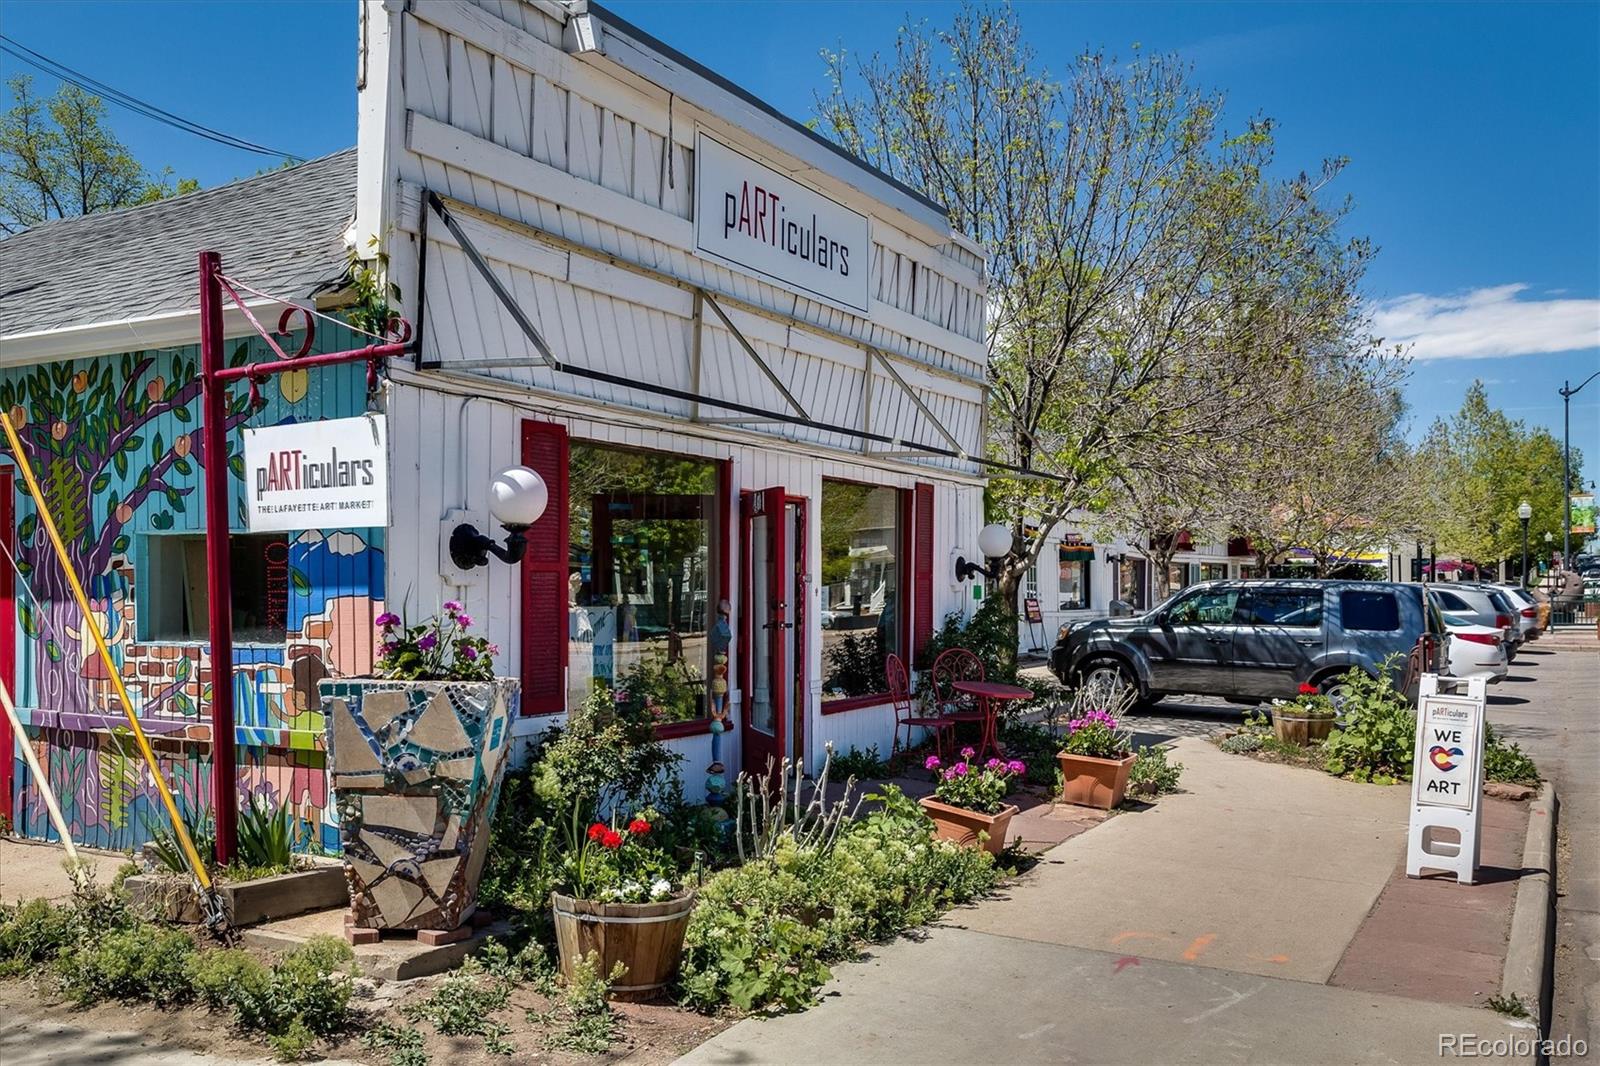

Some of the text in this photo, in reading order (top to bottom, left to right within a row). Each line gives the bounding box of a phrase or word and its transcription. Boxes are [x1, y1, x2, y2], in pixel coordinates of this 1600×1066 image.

[724, 180, 849, 276] pARTiculars
[256, 446, 374, 501] pARTiculars
[258, 500, 372, 514] THE LAFAYETTE ART MARKET
[1434, 728, 1462, 743] WE
[1426, 779, 1461, 795] ART
